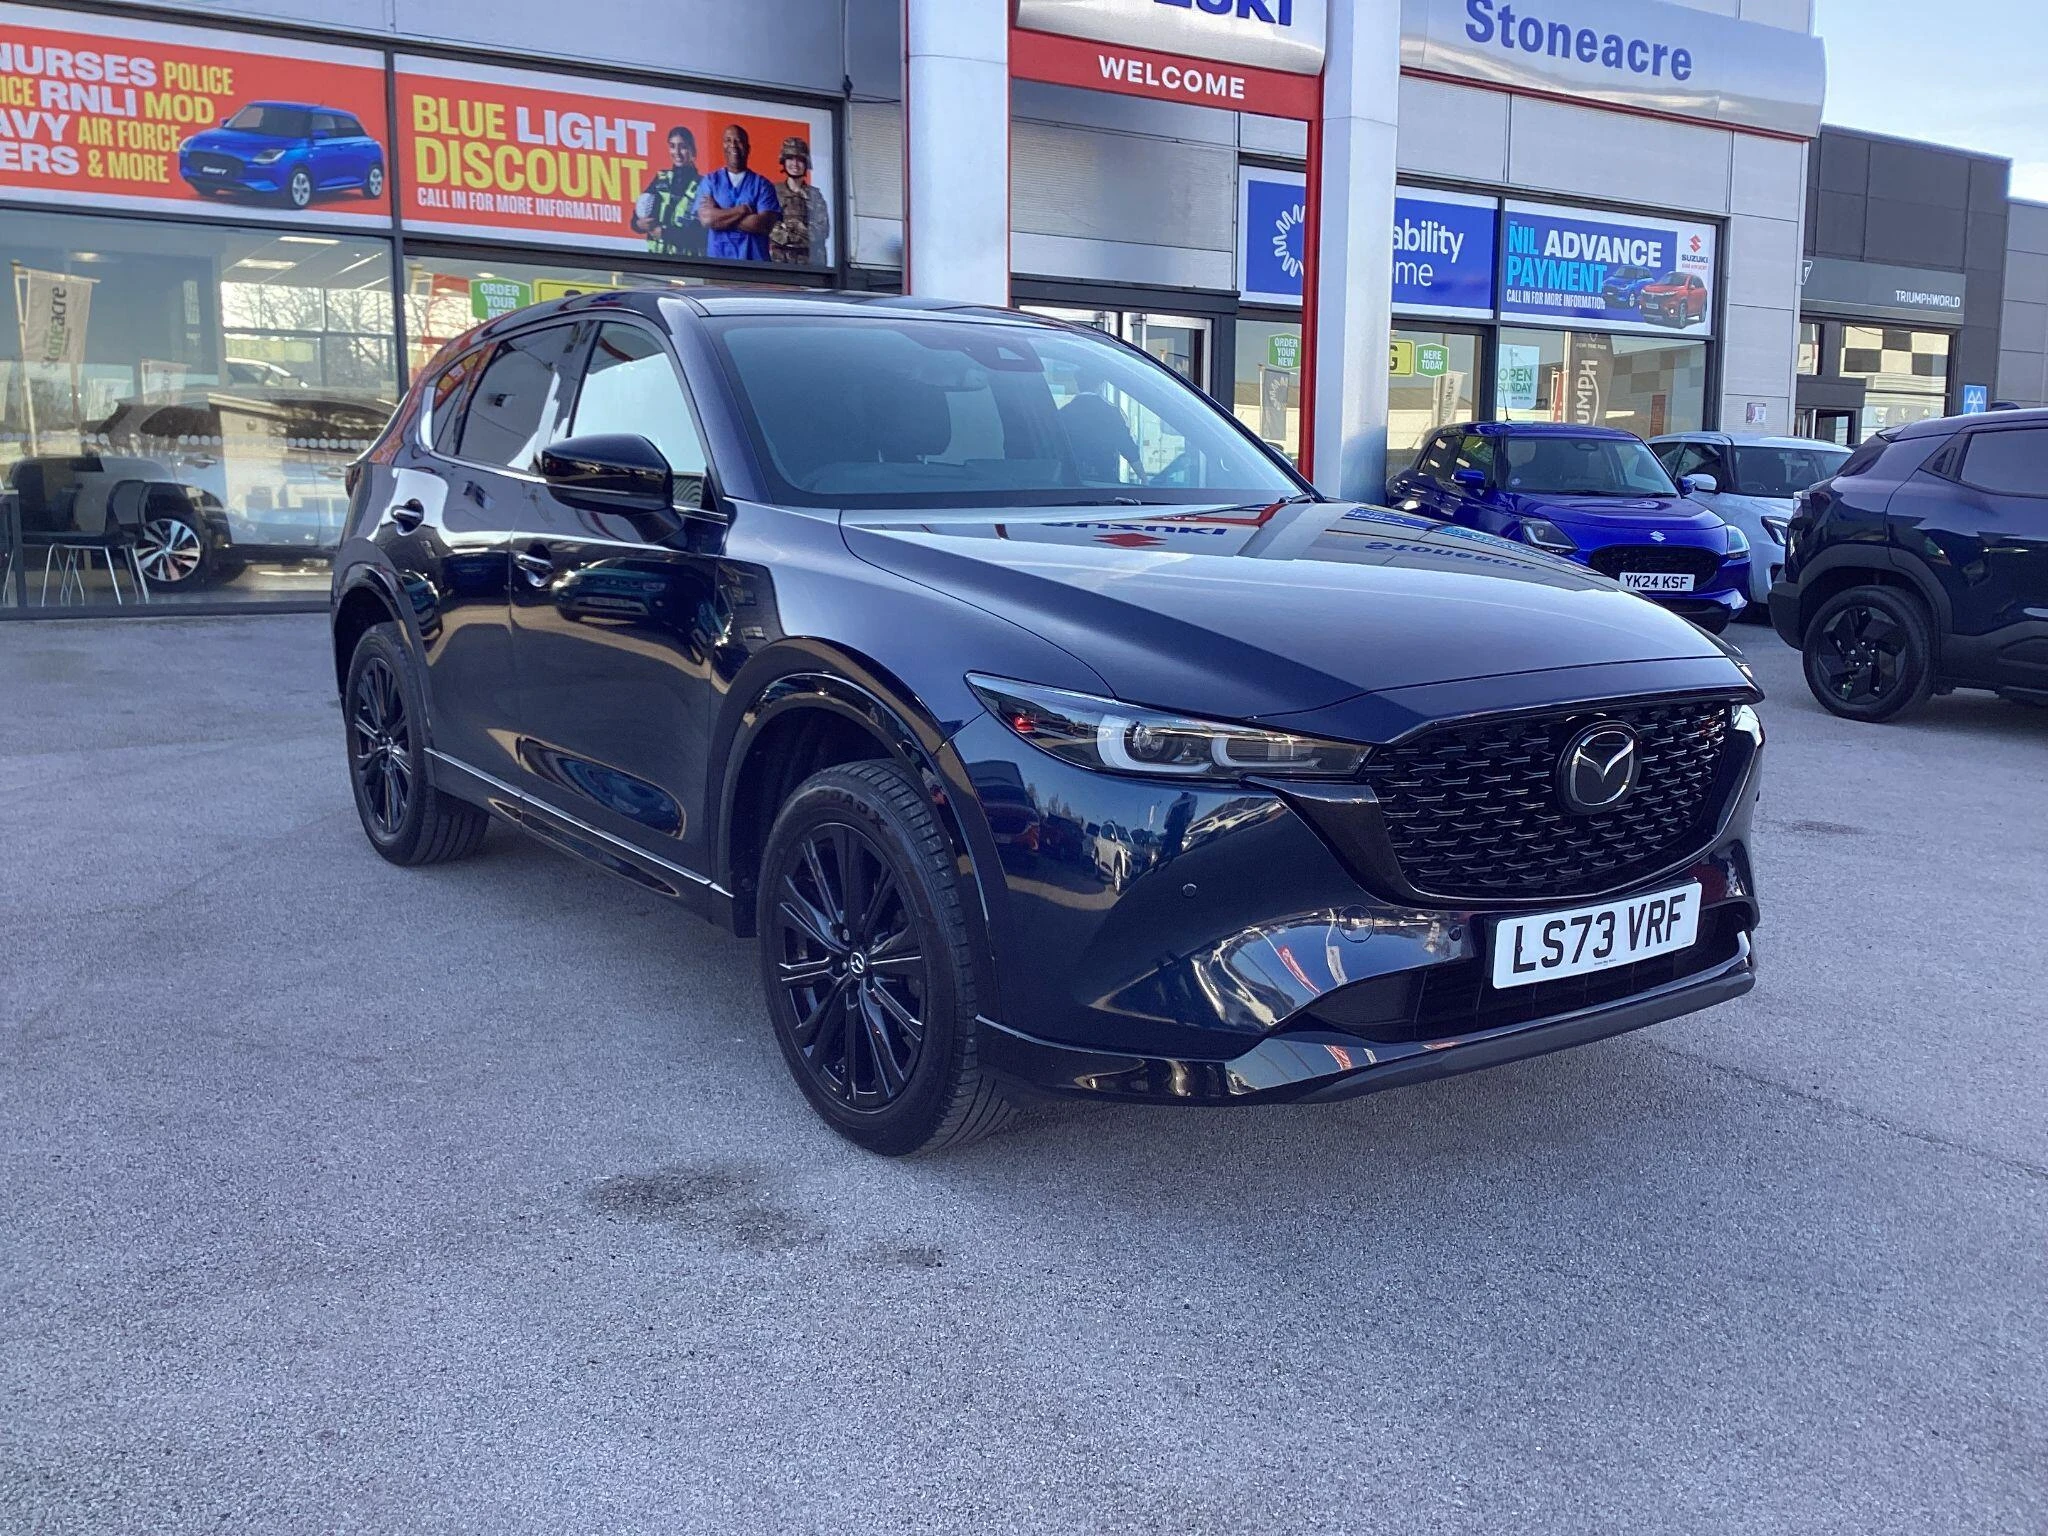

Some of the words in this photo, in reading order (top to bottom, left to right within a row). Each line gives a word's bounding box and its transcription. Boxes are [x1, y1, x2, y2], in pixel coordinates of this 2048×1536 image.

[1465, 0, 1692, 81] Stoneacre
[163, 61, 235, 96] POLICE
[1098, 54, 1246, 99] WELCOME
[39, 79, 138, 117] RNLI
[144, 91, 215, 124] MOD
[78, 116, 114, 147] AIR
[117, 119, 181, 152] FORCE
[412, 94, 507, 141] BLUE
[516, 106, 656, 156] LIGHT
[87, 149, 104, 178] &
[107, 151, 170, 183] MORE
[414, 136, 648, 203] DISCOUNT
[417, 187, 449, 208] CALL
[451, 191, 467, 210] IN
[469, 193, 494, 212] FOR
[496, 195, 534, 215] MORE
[536, 200, 622, 224] INFORMATION
[1509, 225, 1538, 255] NIL
[1544, 229, 1662, 268] ADVANCE
[1681, 254, 1708, 263] SUZUKI
[1393, 261, 1433, 286] me
[1507, 255, 1607, 293] PAYMENT
[480, 282, 519, 297] ORDER
[1507, 289, 1522, 303] CALL
[1523, 290, 1530, 304] IN
[1531, 290, 1543, 305] FOR
[1544, 292, 1563, 306] MORE
[1564, 293, 1606, 310] INFORMATION
[1895, 290, 1960, 308] TRIUMPHWORLD
[485, 295, 516, 309] YOUR
[1274, 337, 1298, 347] ORDER
[1277, 347, 1296, 358] YOUR
[1278, 357, 1294, 366] NEW
[1421, 359, 1443, 370] TODAY
[1423, 350, 1442, 360] HERE
[1499, 367, 1532, 381] OPEN
[1498, 383, 1532, 393] SUNDAY
[1625, 575, 1658, 588] YK24
[1662, 576, 1688, 589] KSF
[1512, 910, 1616, 974] LS73
[1628, 893, 1686, 951] VRF
